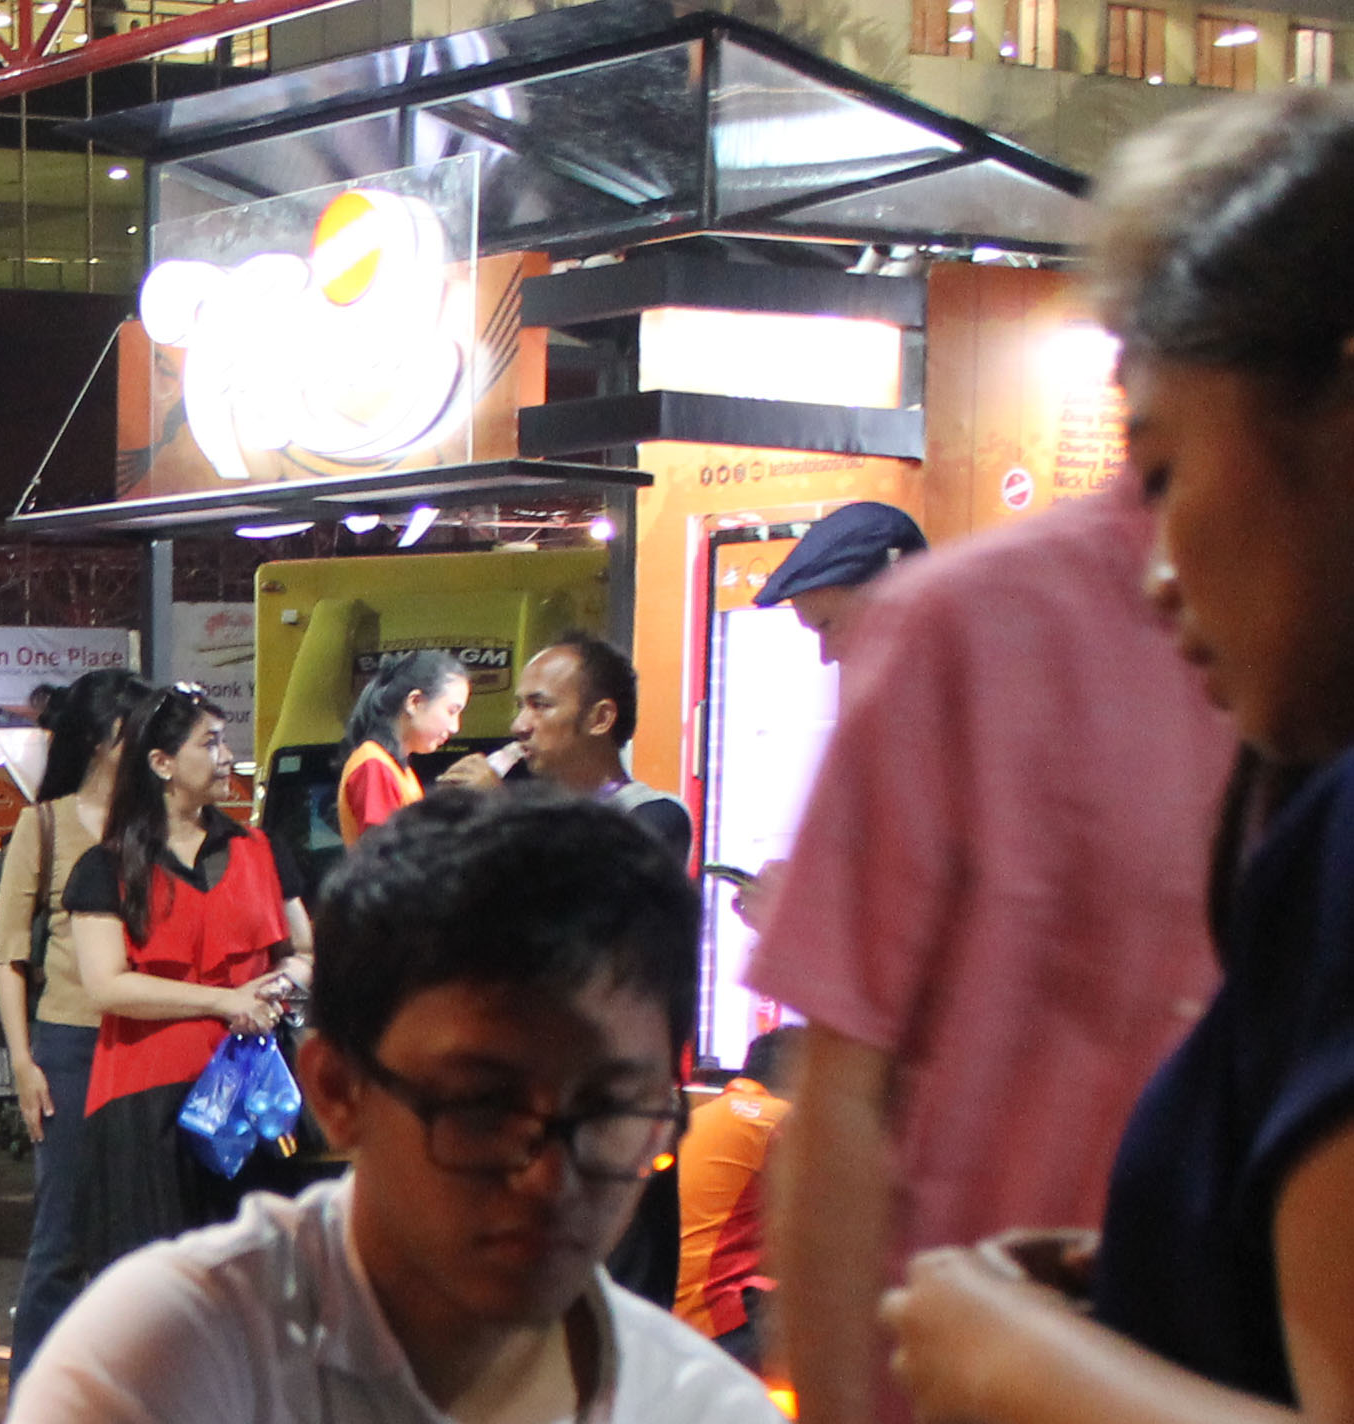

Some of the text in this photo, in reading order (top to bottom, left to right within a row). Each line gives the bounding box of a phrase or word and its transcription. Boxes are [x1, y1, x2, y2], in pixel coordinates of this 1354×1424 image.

[17, 647, 60, 667] One
[68, 647, 123, 667] Place
[458, 649, 507, 667] GM
